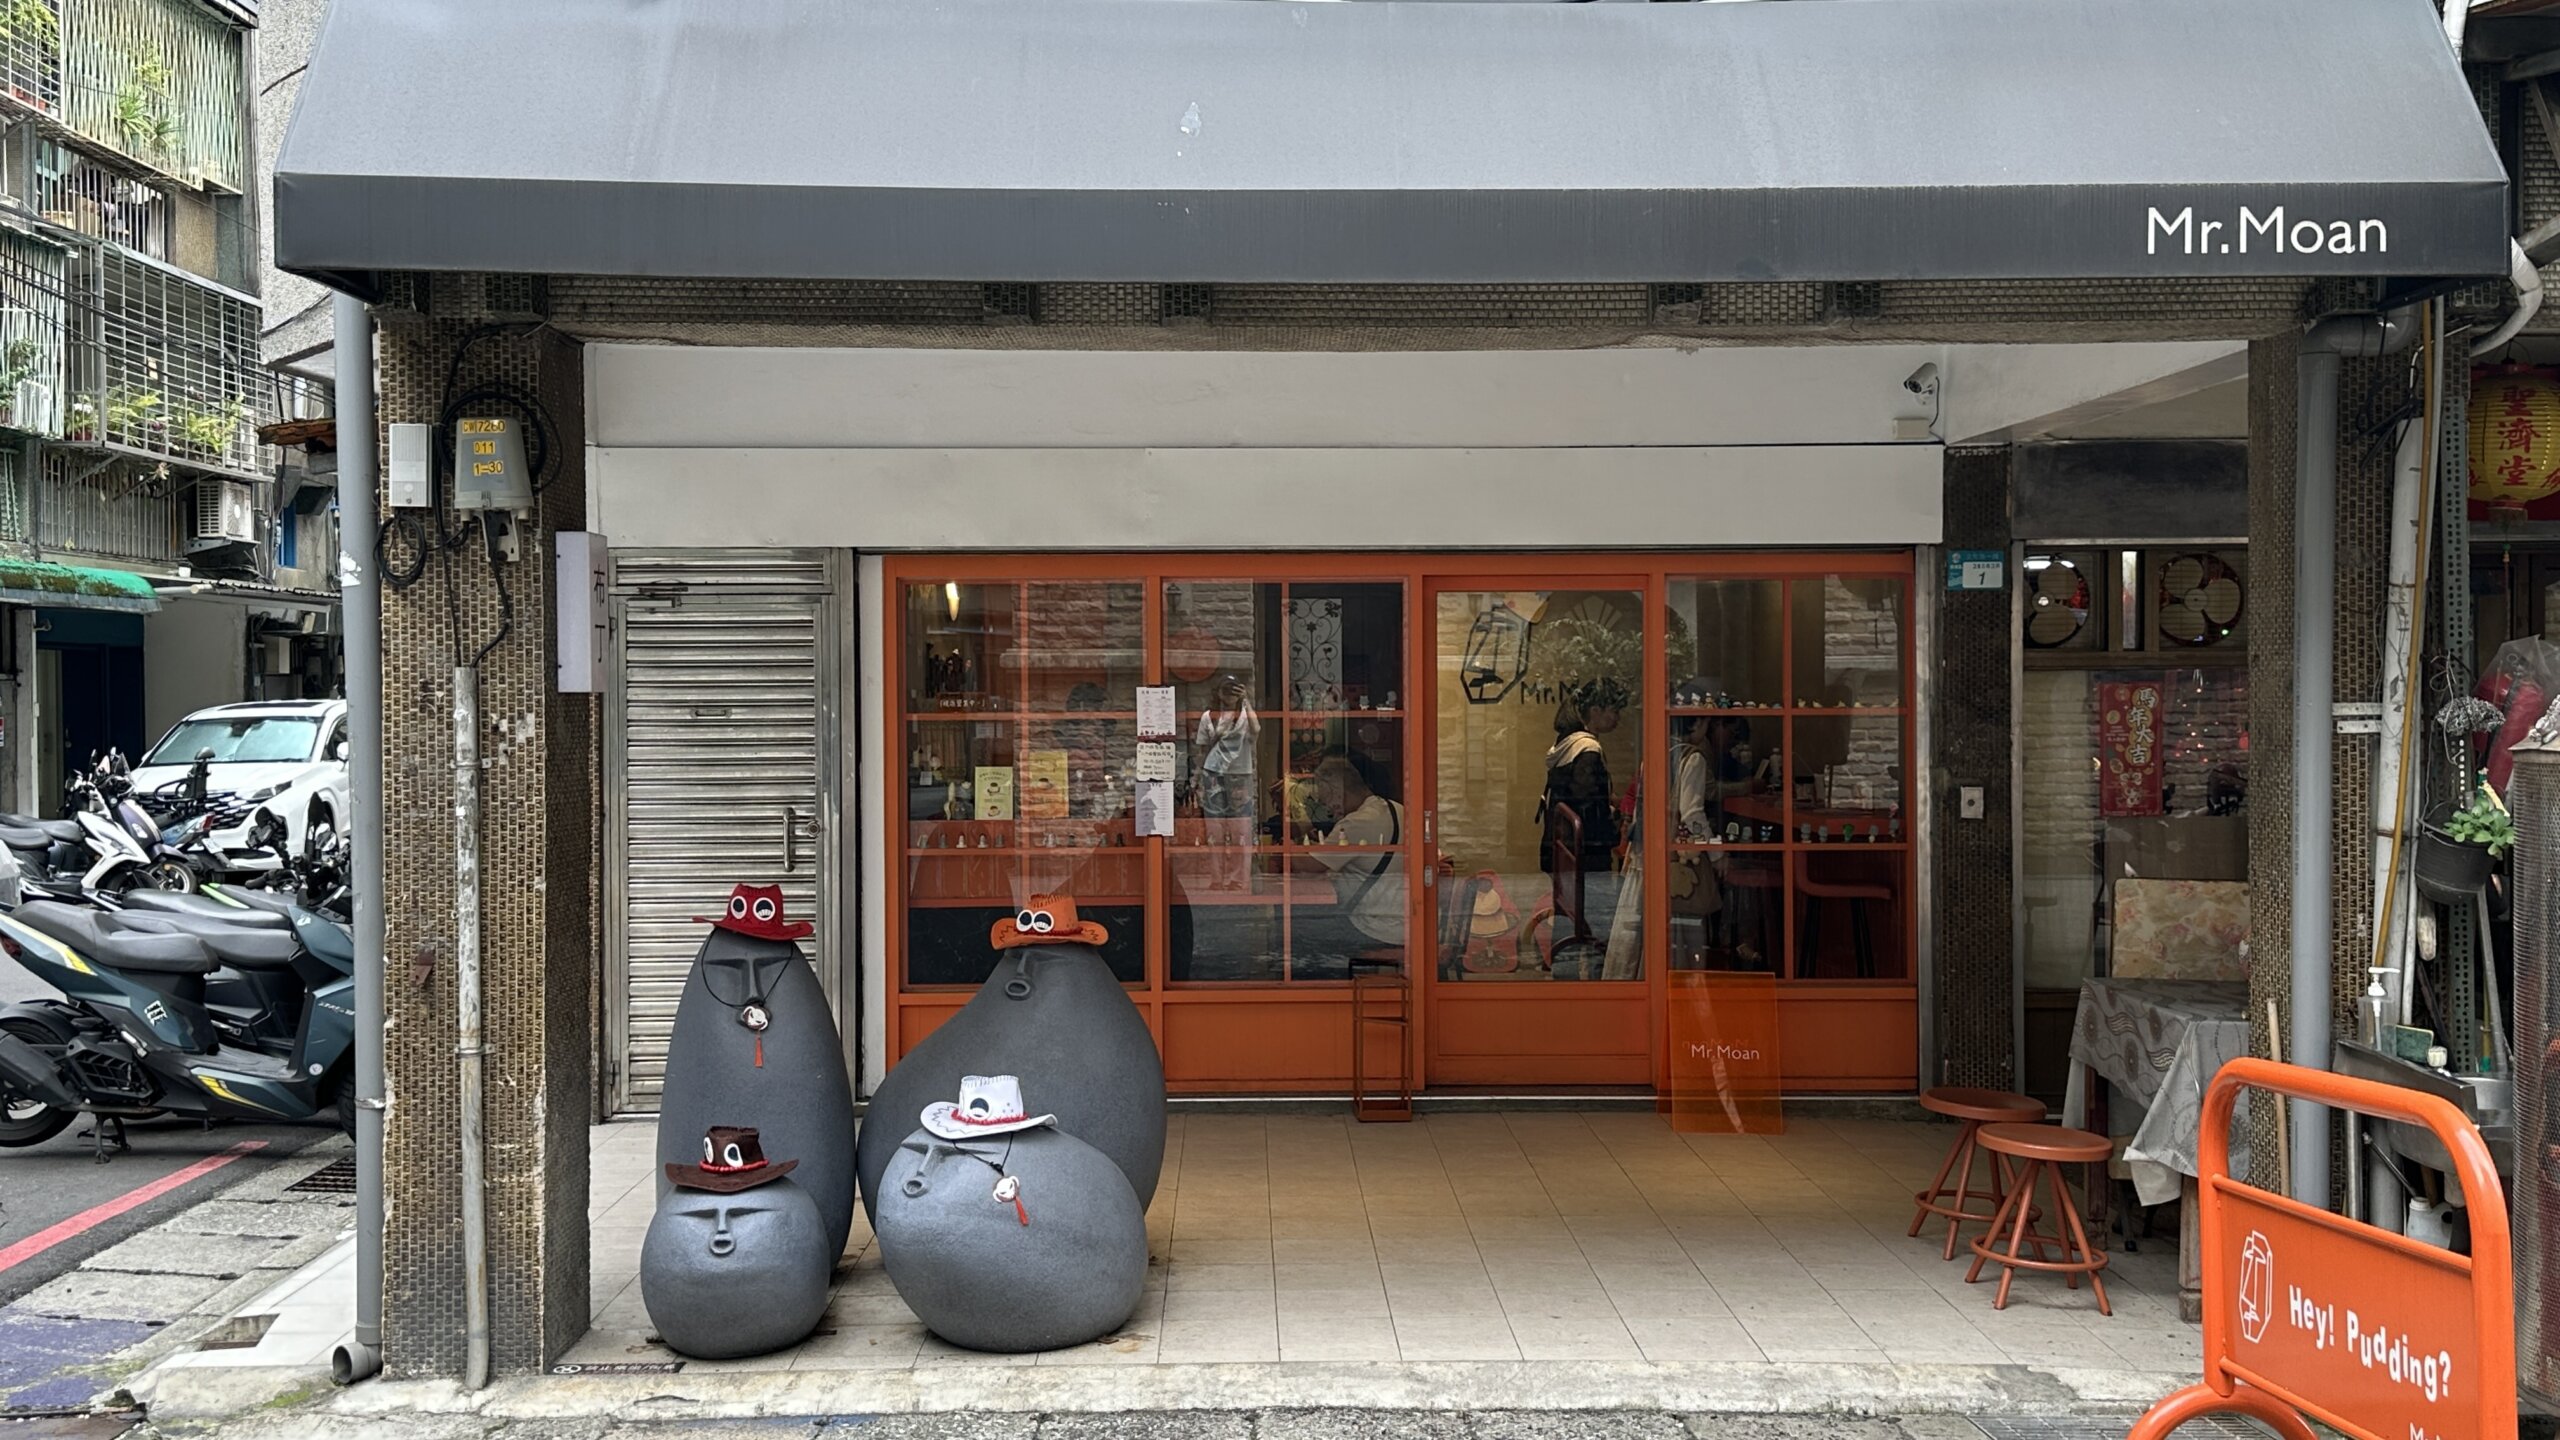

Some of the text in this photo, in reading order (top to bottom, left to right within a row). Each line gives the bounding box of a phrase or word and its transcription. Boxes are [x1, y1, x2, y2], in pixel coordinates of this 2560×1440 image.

[2147, 205, 2388, 255] Mr.Moan
[1979, 571, 1986, 586] 1
[2129, 687, 2157, 765] 馬年大吉
[1691, 1044, 1760, 1060] Mr.Moan
[2289, 1284, 2451, 1402] Hey! Pudding?
